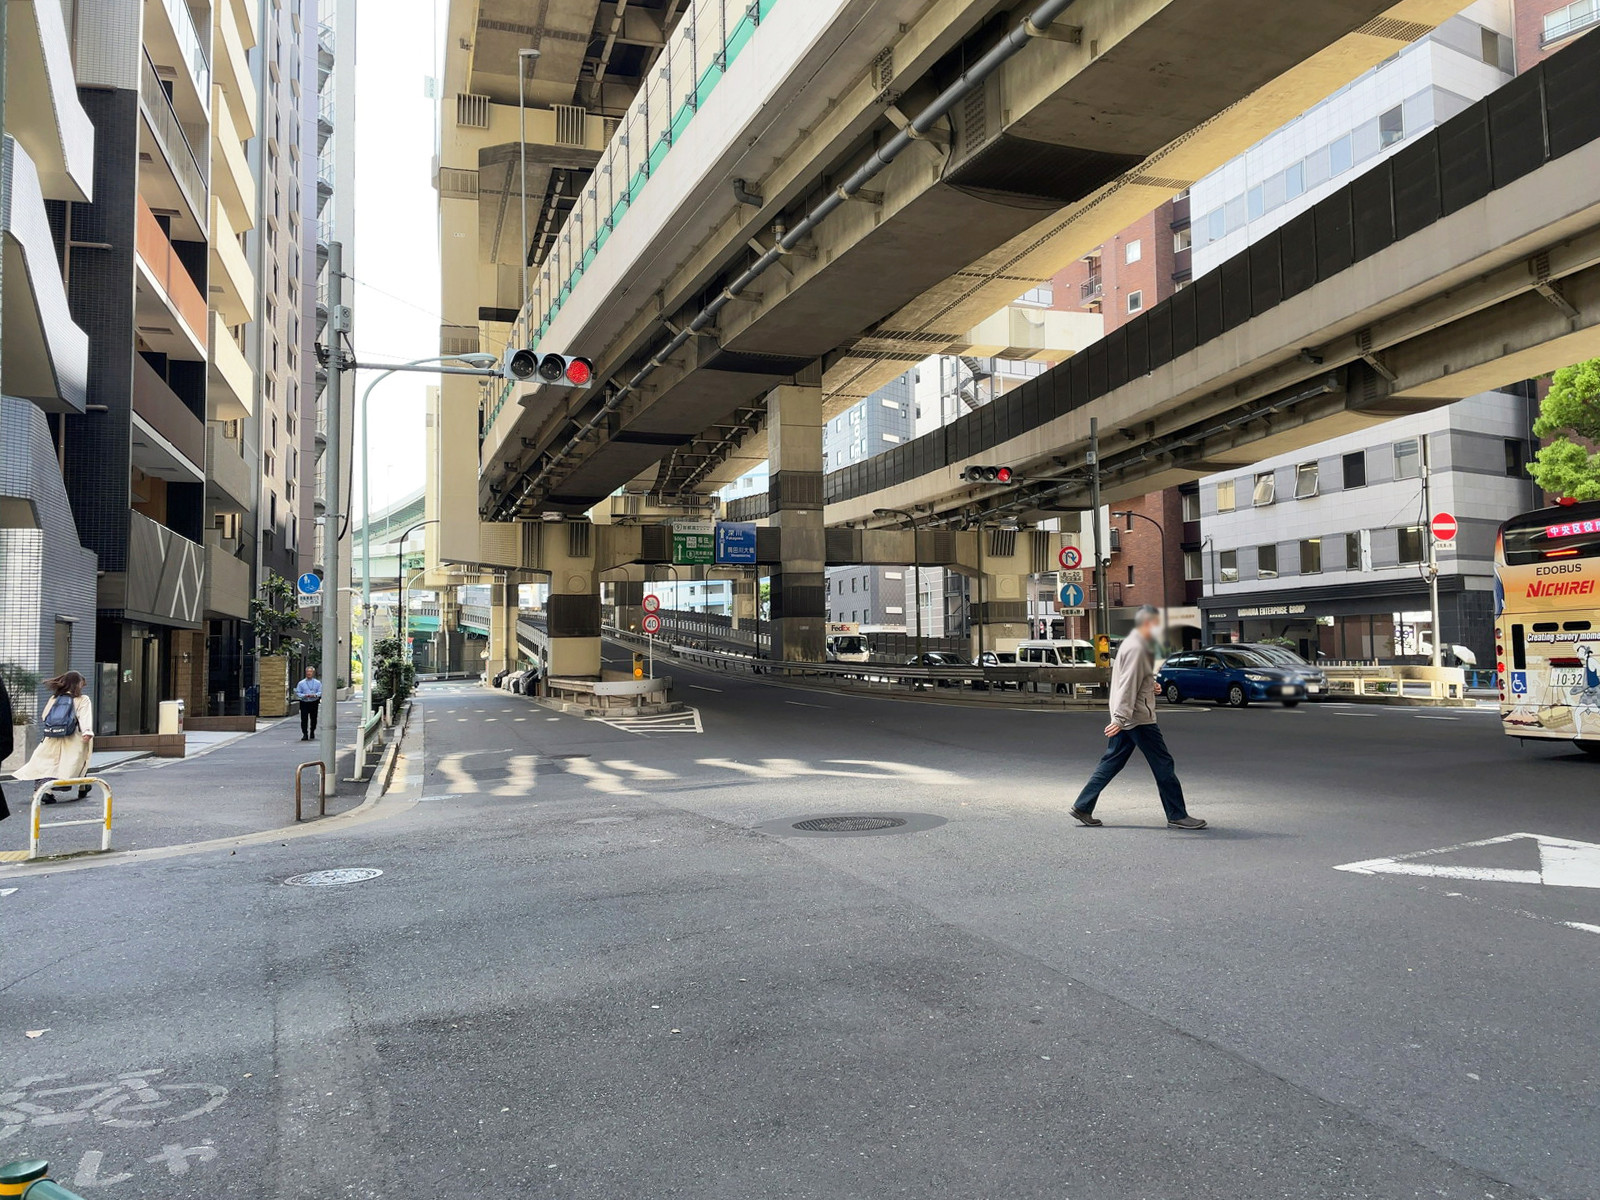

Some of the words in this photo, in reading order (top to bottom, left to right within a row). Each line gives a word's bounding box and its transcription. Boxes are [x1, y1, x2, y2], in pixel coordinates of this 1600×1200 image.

[1536, 564, 1582, 576] EDOBUS
[1260, 606, 1288, 615] ENTERPRISE
[1289, 605, 1306, 614] GROUP
[647, 619, 657, 628] 40
[831, 624, 851, 632] FedEx
[1527, 632, 1555, 643] Creating
[1555, 632, 1579, 643] savory
